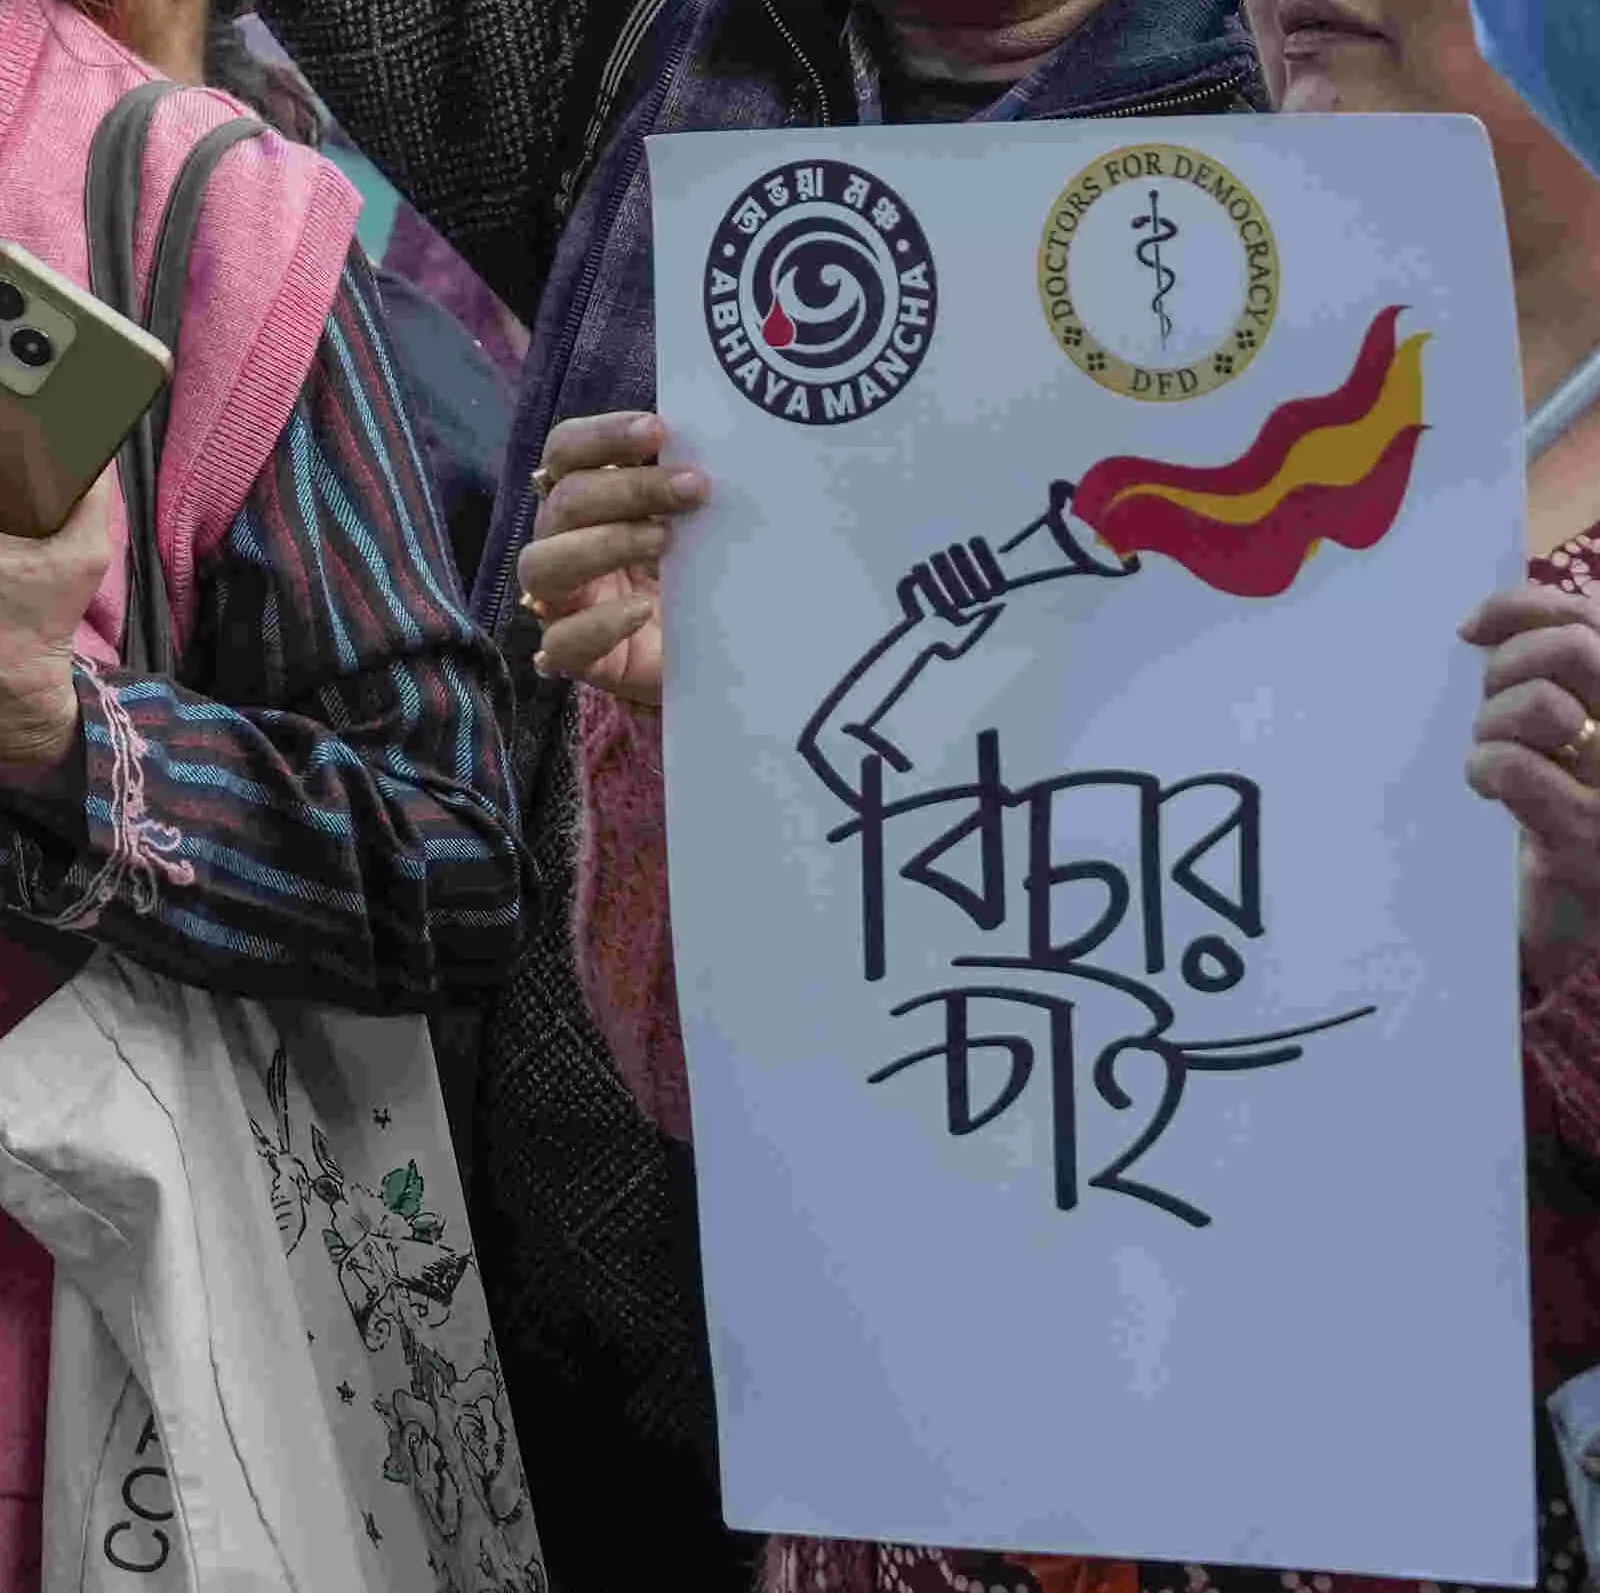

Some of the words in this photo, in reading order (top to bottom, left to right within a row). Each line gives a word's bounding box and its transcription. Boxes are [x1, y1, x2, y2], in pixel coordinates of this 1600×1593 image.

[1045, 176, 1103, 321] DOCTORS
[1103, 151, 1164, 186] FOR
[1173, 155, 1273, 326] DEMOCRACY
[710, 267, 811, 419] ABHAYA
[821, 260, 930, 420] MANCHA
[1129, 367, 1199, 396] DFD
[827, 728, 1265, 993] বিচার
[867, 956, 1378, 1228] চাই
